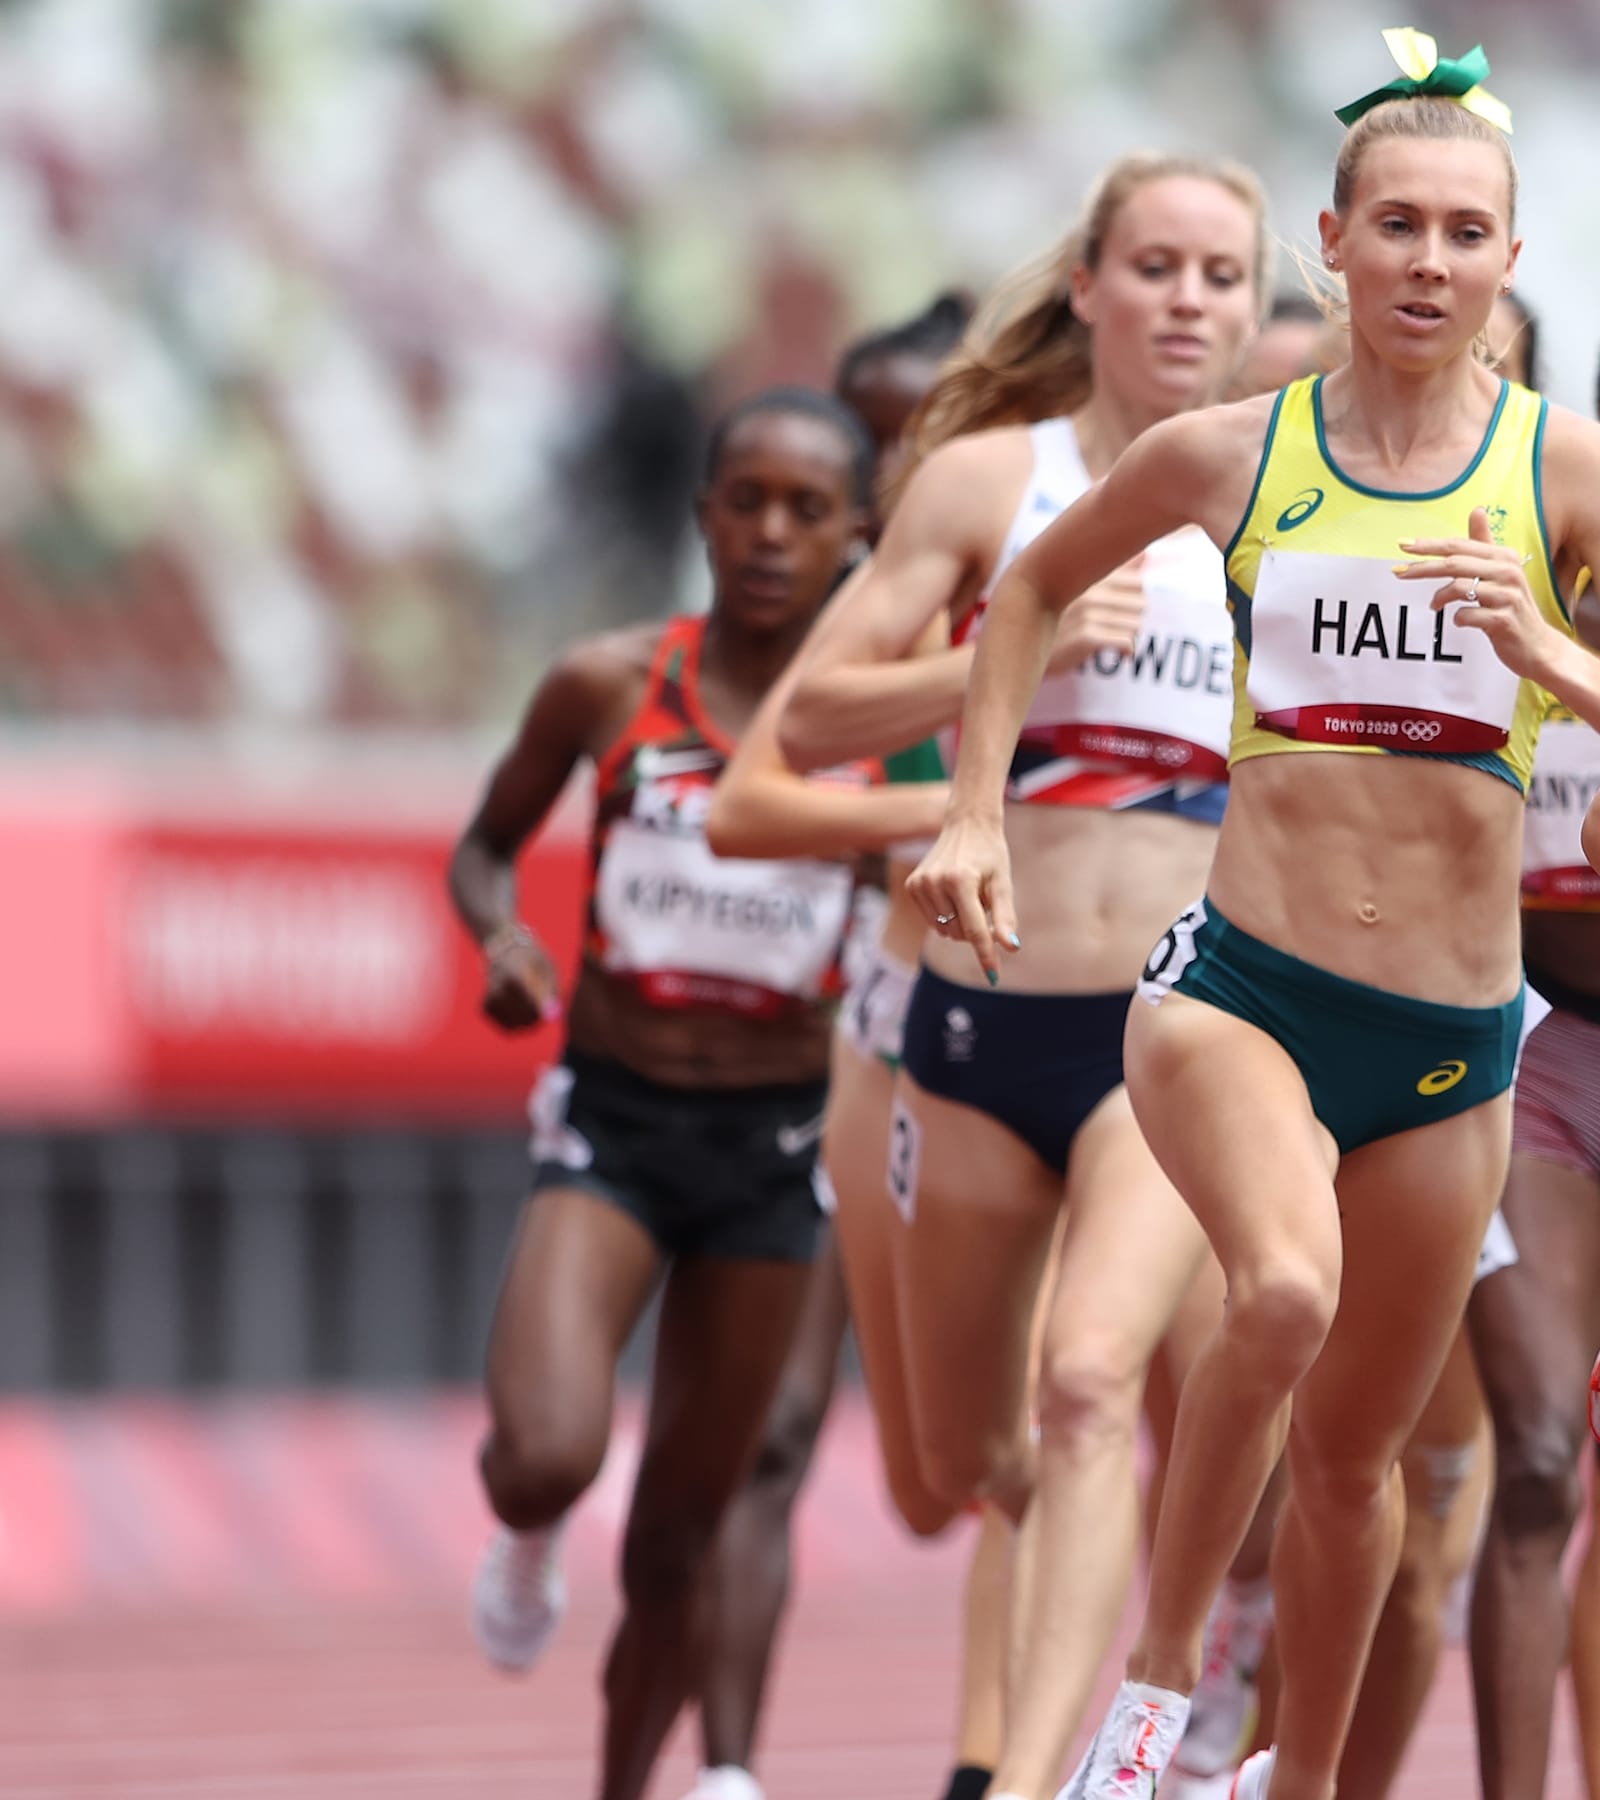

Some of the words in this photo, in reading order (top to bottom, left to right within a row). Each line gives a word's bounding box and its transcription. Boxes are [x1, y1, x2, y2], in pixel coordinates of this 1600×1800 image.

[1312, 598, 1462, 663] HALL
[1078, 636, 1225, 694] OWDE
[1324, 716, 1365, 733] TOKYO
[1366, 720, 1398, 735] 2020
